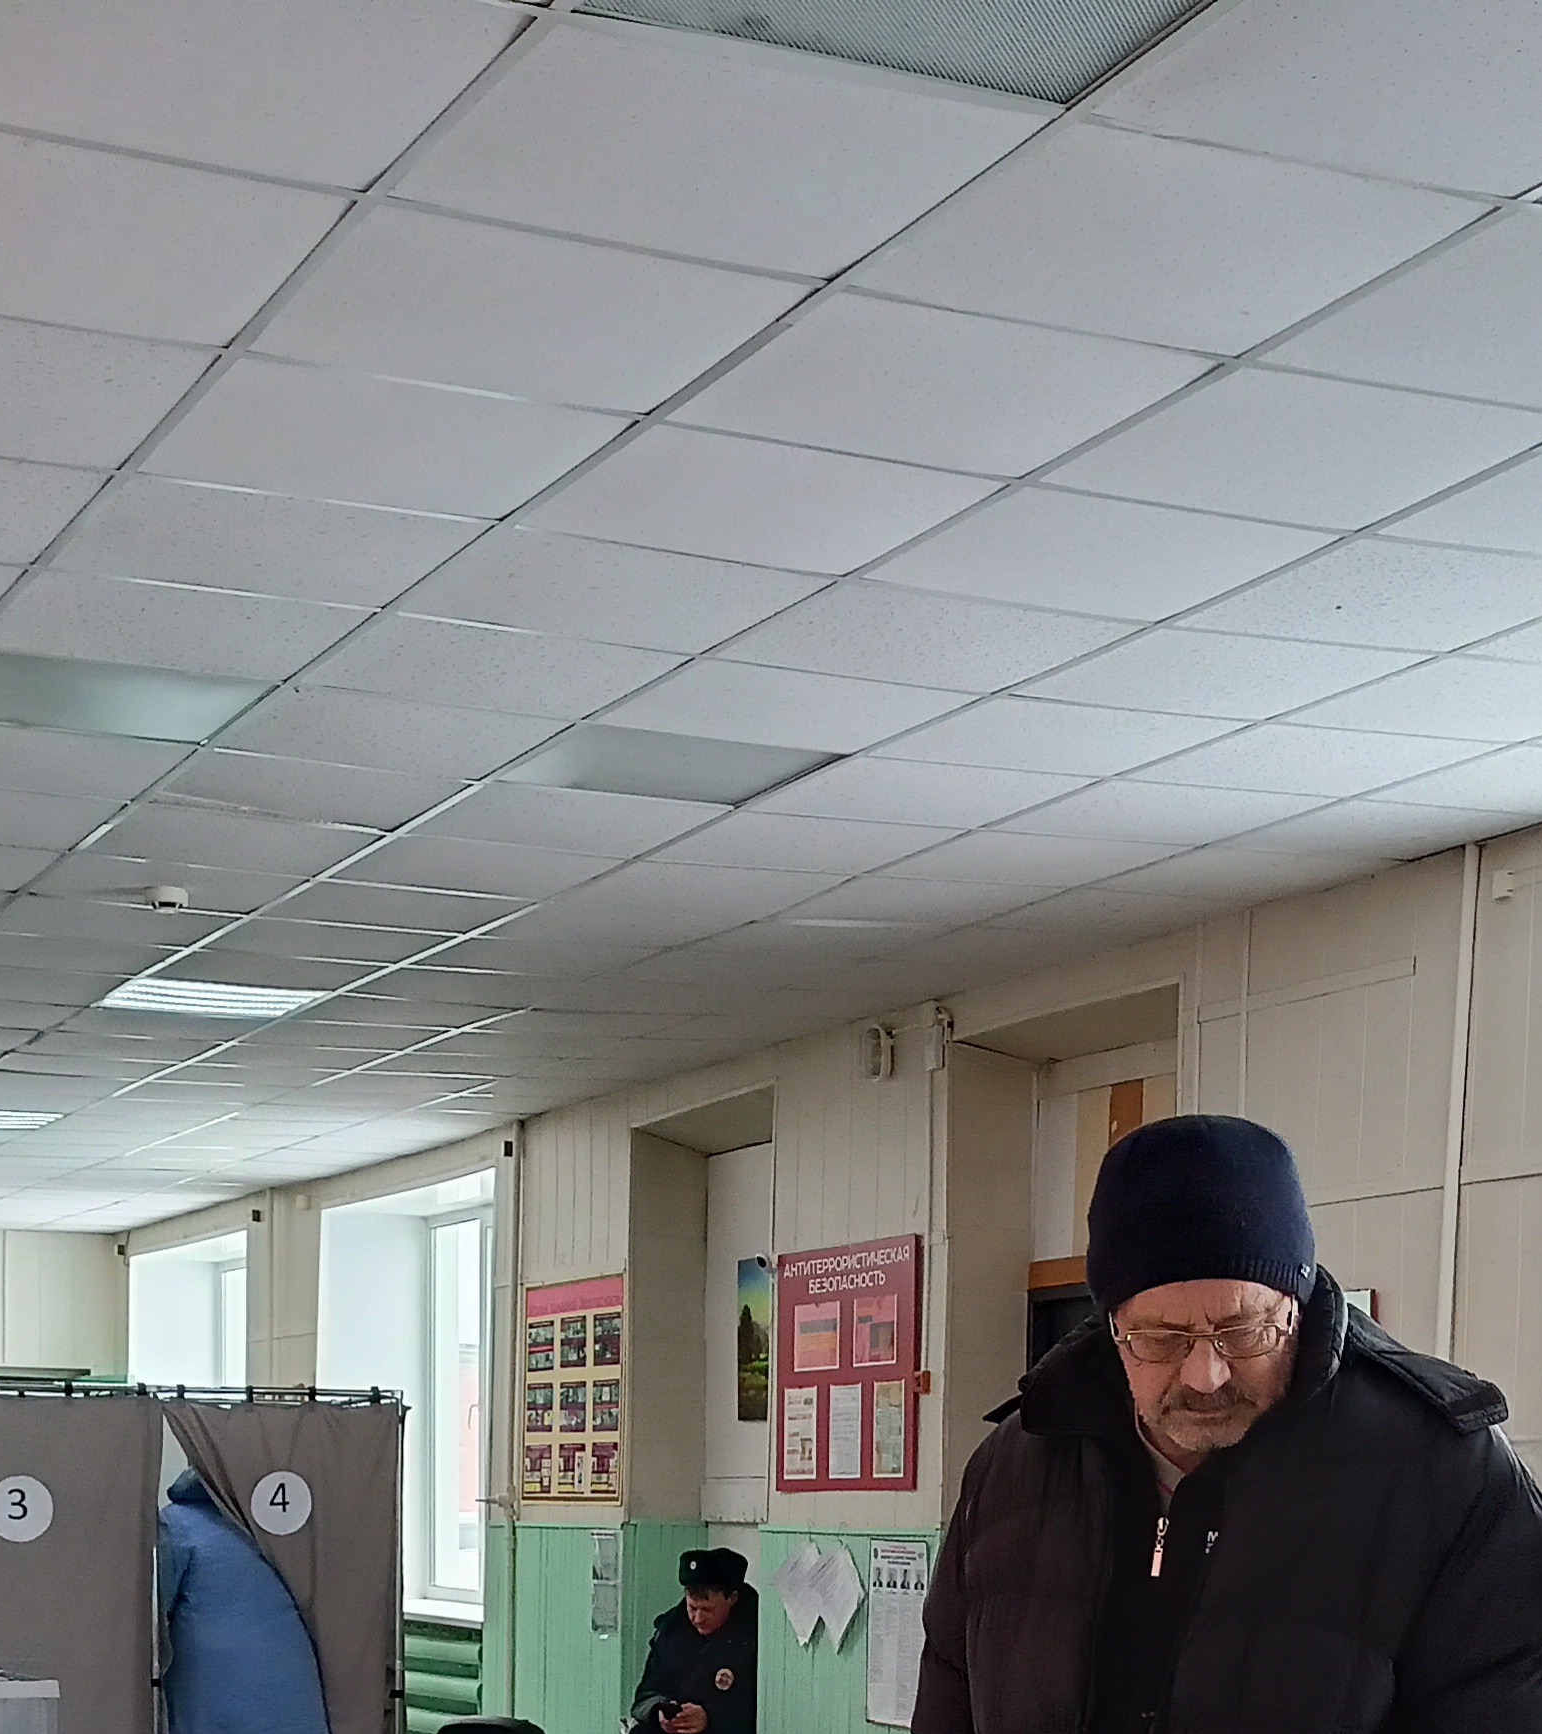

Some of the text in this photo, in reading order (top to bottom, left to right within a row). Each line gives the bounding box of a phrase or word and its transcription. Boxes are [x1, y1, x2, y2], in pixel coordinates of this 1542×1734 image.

[783, 1245, 910, 1278] АНТИТЕРРОРИСТИЧЕСКАЯ
[808, 1270, 886, 1294] БЕЗОПАСНОСТЬ
[8, 1488, 28, 1520] 3
[269, 1482, 290, 1513] 4
